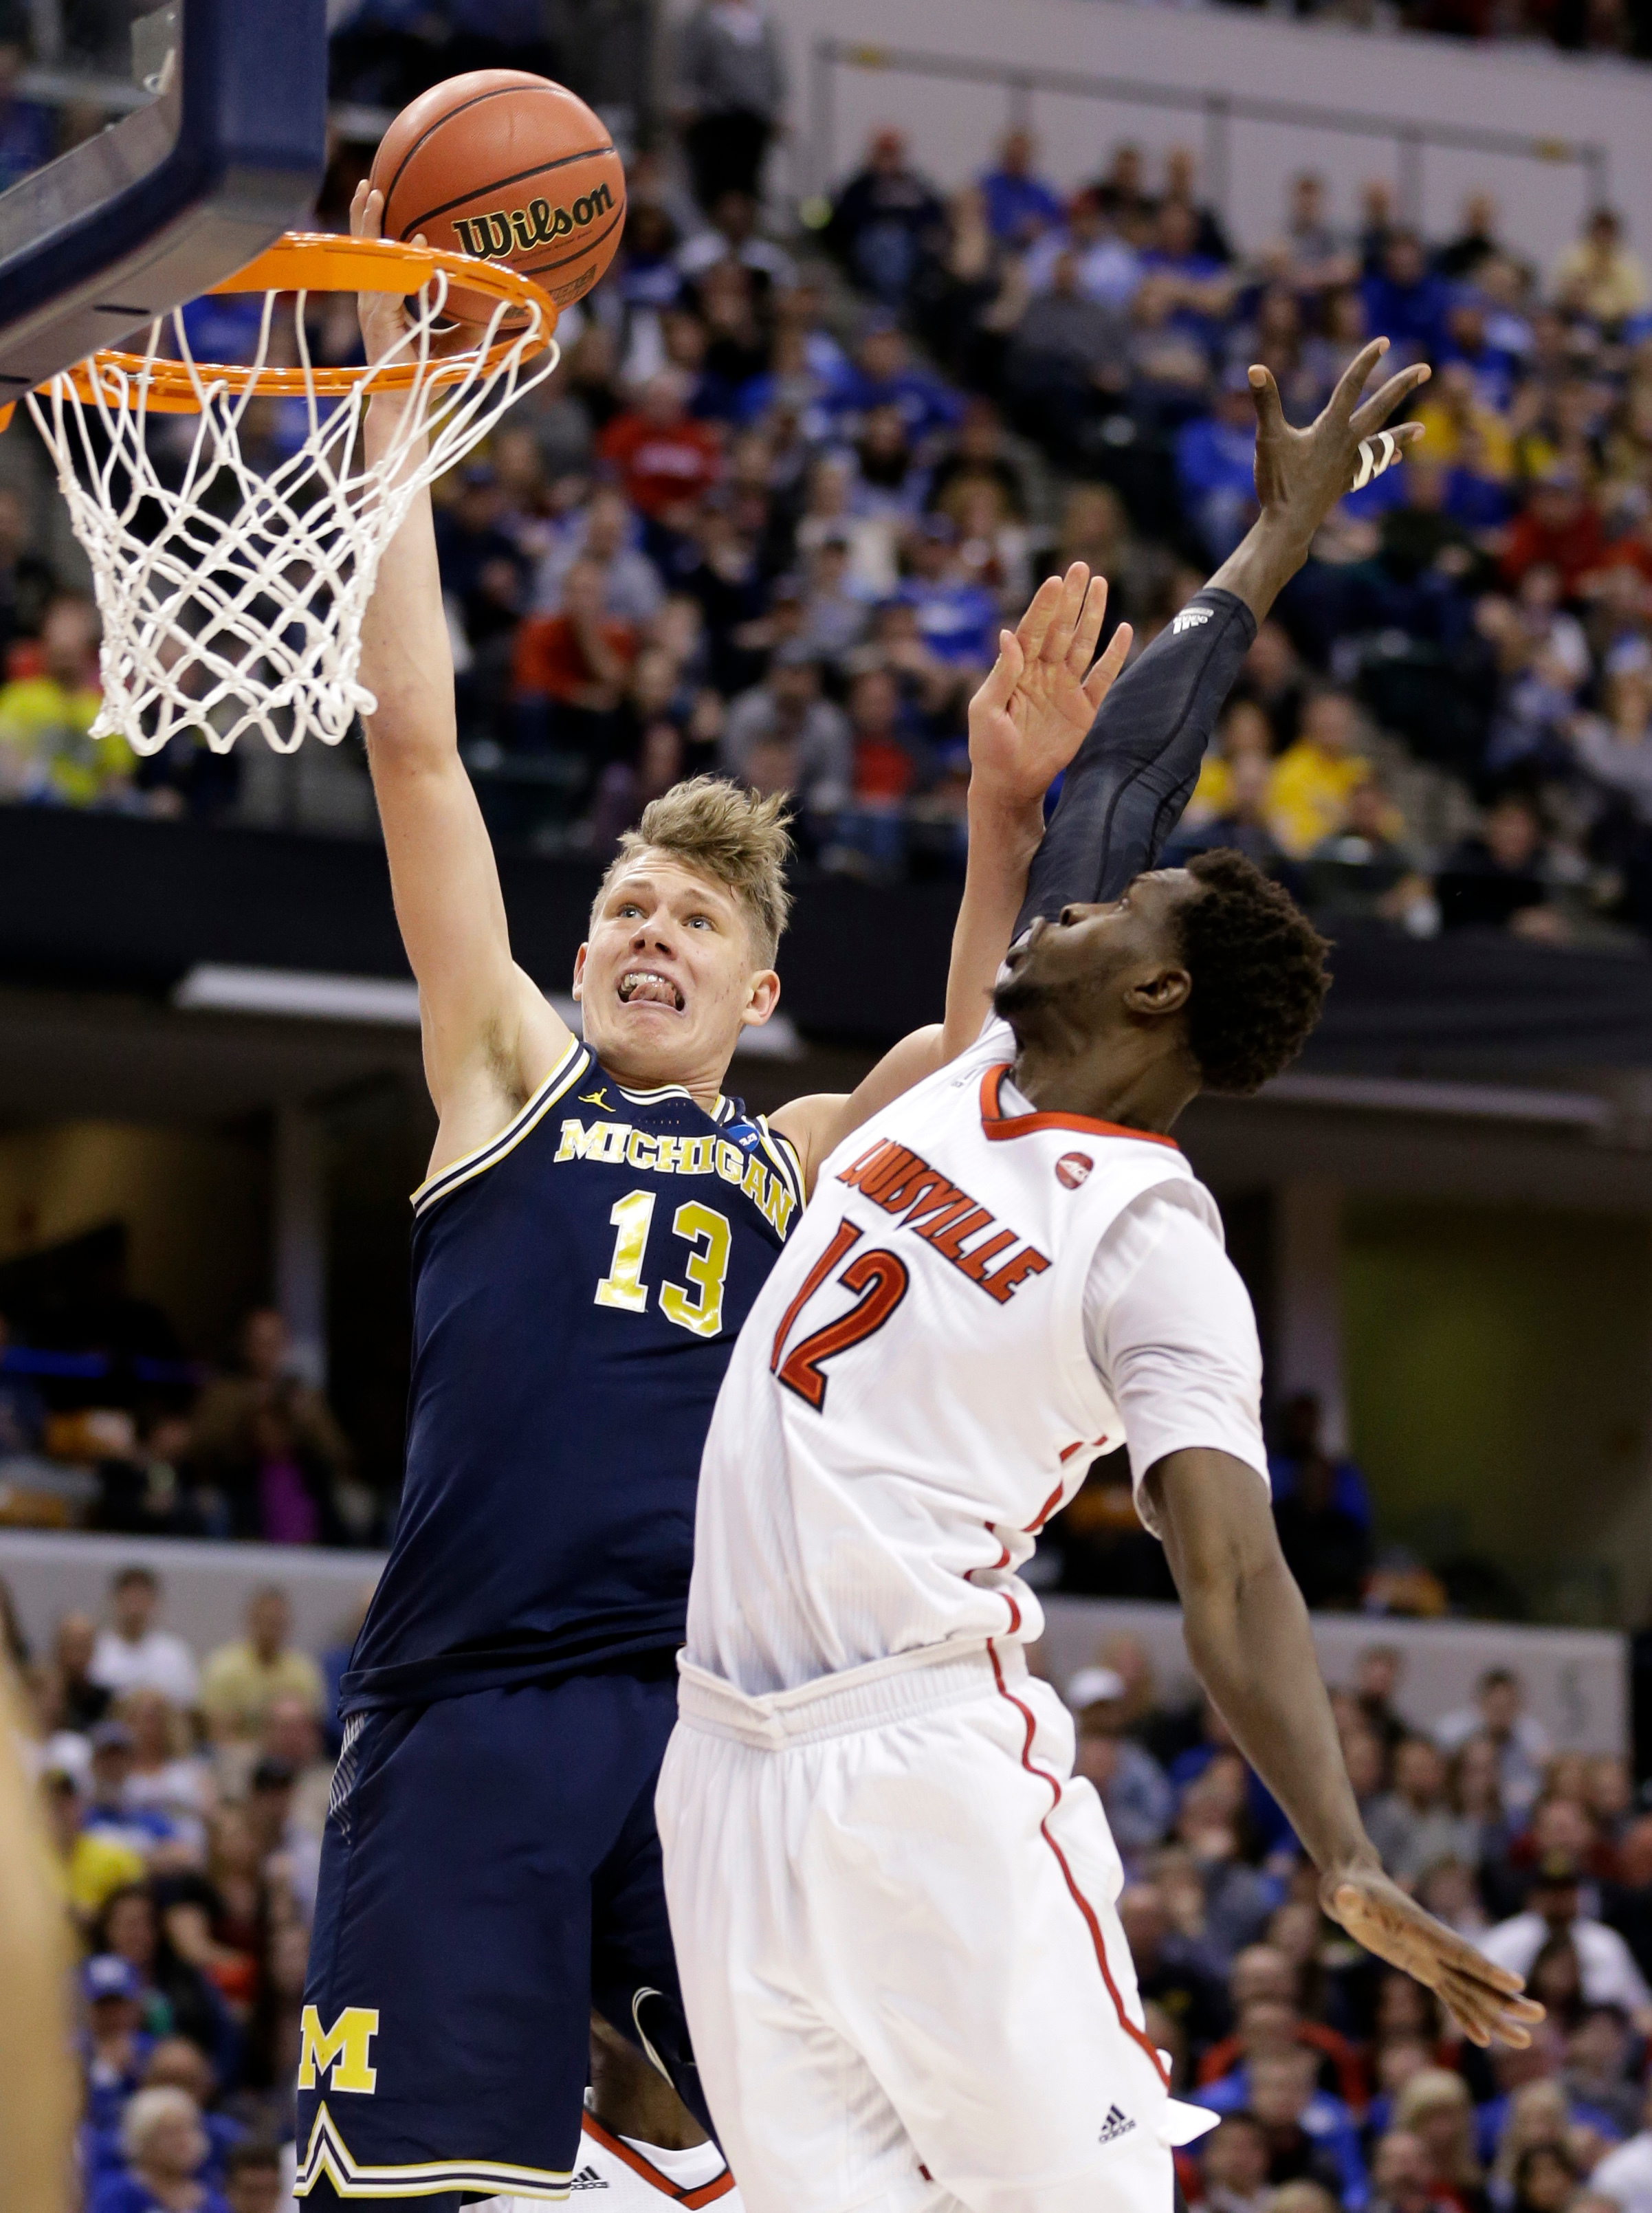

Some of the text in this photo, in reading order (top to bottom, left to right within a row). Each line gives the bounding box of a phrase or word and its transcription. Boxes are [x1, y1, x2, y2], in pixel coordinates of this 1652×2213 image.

[451, 183, 615, 261] Wilson
[554, 1119, 796, 1242] MICHIGAN
[594, 1189, 731, 1337] 13
[770, 1216, 910, 1414] 12
[298, 2005, 379, 2095] M
